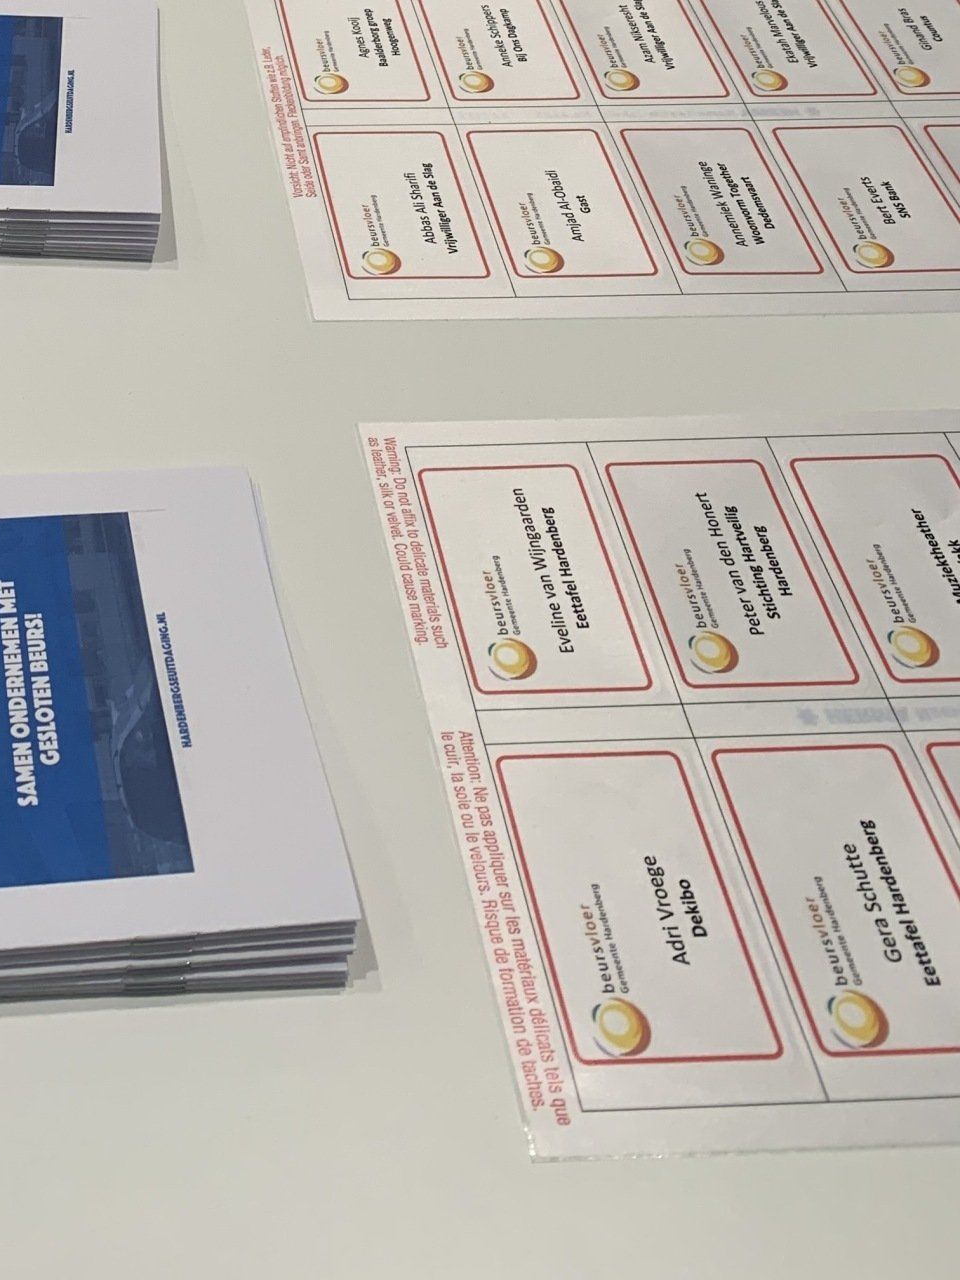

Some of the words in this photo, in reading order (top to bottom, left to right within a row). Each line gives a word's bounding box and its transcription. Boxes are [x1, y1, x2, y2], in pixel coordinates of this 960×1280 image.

[347, 17, 363, 35] Kooij
[363, 8, 378, 27] groep
[480, 4, 502, 39] Schippers
[499, 8, 518, 39] Dagkamp
[618, 4, 645, 42] Nikseresht
[639, 11, 650, 20] de
[644, 20, 658, 34] Aan
[755, 0, 784, 38] Marvelous
[777, 9, 789, 19] de
[782, 18, 797, 32] Aan
[897, 7, 915, 24] Bras
[919, 15, 943, 43] Countus
[355, 35, 370, 59] Agnes
[369, 27, 389, 67] Baalderborg
[381, 17, 401, 57] Hoogenweg
[493, 39, 513, 68] Anneke
[511, 39, 523, 53] Ons
[638, 42, 656, 64] Azam
[651, 34, 676, 71] Vrijwilliger
[776, 38, 800, 64] Ekatah
[791, 32, 818, 69] Vrijwilliger
[906, 24, 933, 51] Ginand
[515, 53, 528, 63] Bij
[403, 172, 424, 201] Sharifi
[421, 162, 435, 179] Slag
[426, 180, 438, 191] de
[697, 161, 724, 200] Waninge
[716, 162, 741, 199] Together
[412, 201, 428, 215] Ali
[431, 191, 445, 209] Aan
[544, 169, 573, 211] Al-Obaidi
[575, 195, 591, 214] Gast
[740, 176, 776, 230] Dedemsvaart
[859, 176, 884, 204] Everts
[880, 180, 901, 201] Bank
[561, 212, 585, 242] Amjad
[715, 201, 749, 247] Annemiek
[735, 199, 765, 245] Woonvorm
[875, 205, 897, 225] Bert
[892, 202, 912, 219] SNS
[419, 215, 437, 245] Abbas
[436, 209, 459, 255] Vrijwilliger
[383, 436, 402, 476] Warning:
[392, 477, 407, 491] Do
[397, 491, 413, 507] not
[400, 507, 417, 528] affix
[512, 488, 548, 571] Wijngaarden
[694, 491, 724, 537] Honert
[406, 529, 420, 539] to
[541, 507, 573, 577] Hardenberg
[724, 505, 757, 563] Hartveilig
[409, 540, 430, 577] delicate
[683, 548, 705, 591] Hardenberg
[716, 541, 736, 567] den
[753, 525, 793, 597] Hardenberg
[872, 543, 898, 585] Hardenberg
[491, 555, 510, 597] Hardenberg
[539, 574, 557, 600] van
[728, 569, 747, 595] van
[749, 565, 781, 619] Stichting
[866, 559, 905, 624] beursvloer
[419, 578, 443, 623] materials
[482, 571, 509, 636] beursvloer
[561, 580, 590, 629] Eettafel
[675, 563, 708, 629] beursvloer
[699, 591, 719, 629] Gemeente
[893, 586, 917, 624] Gemeente
[505, 598, 521, 637] Gemeente
[548, 602, 575, 653] Eveline
[738, 597, 765, 635] Peter
[23, 612, 49, 673] BEURS!
[425, 624, 449, 649] such
[0, 616, 31, 739] ONDERNEMEN
[155, 611, 193, 749] HARDENBERGSEUITDAGING.NL
[30, 675, 61, 766] GESLOTEN
[11, 741, 39, 807] SAMEN
[843, 843, 883, 913] Schutte
[860, 820, 910, 914] Hardenberg
[643, 855, 675, 921] Vroege
[813, 875, 841, 933] Hardenberg
[590, 883, 613, 941] Hardenberg
[678, 879, 708, 938] Dekibo
[580, 904, 616, 994] beursvloer
[661, 925, 691, 966] Adri
[806, 898, 848, 986] beursvloer
[874, 917, 903, 963] Gera
[899, 920, 940, 986] Eettafel
[608, 942, 630, 995] Gemeente
[837, 934, 863, 987] Gemeente
